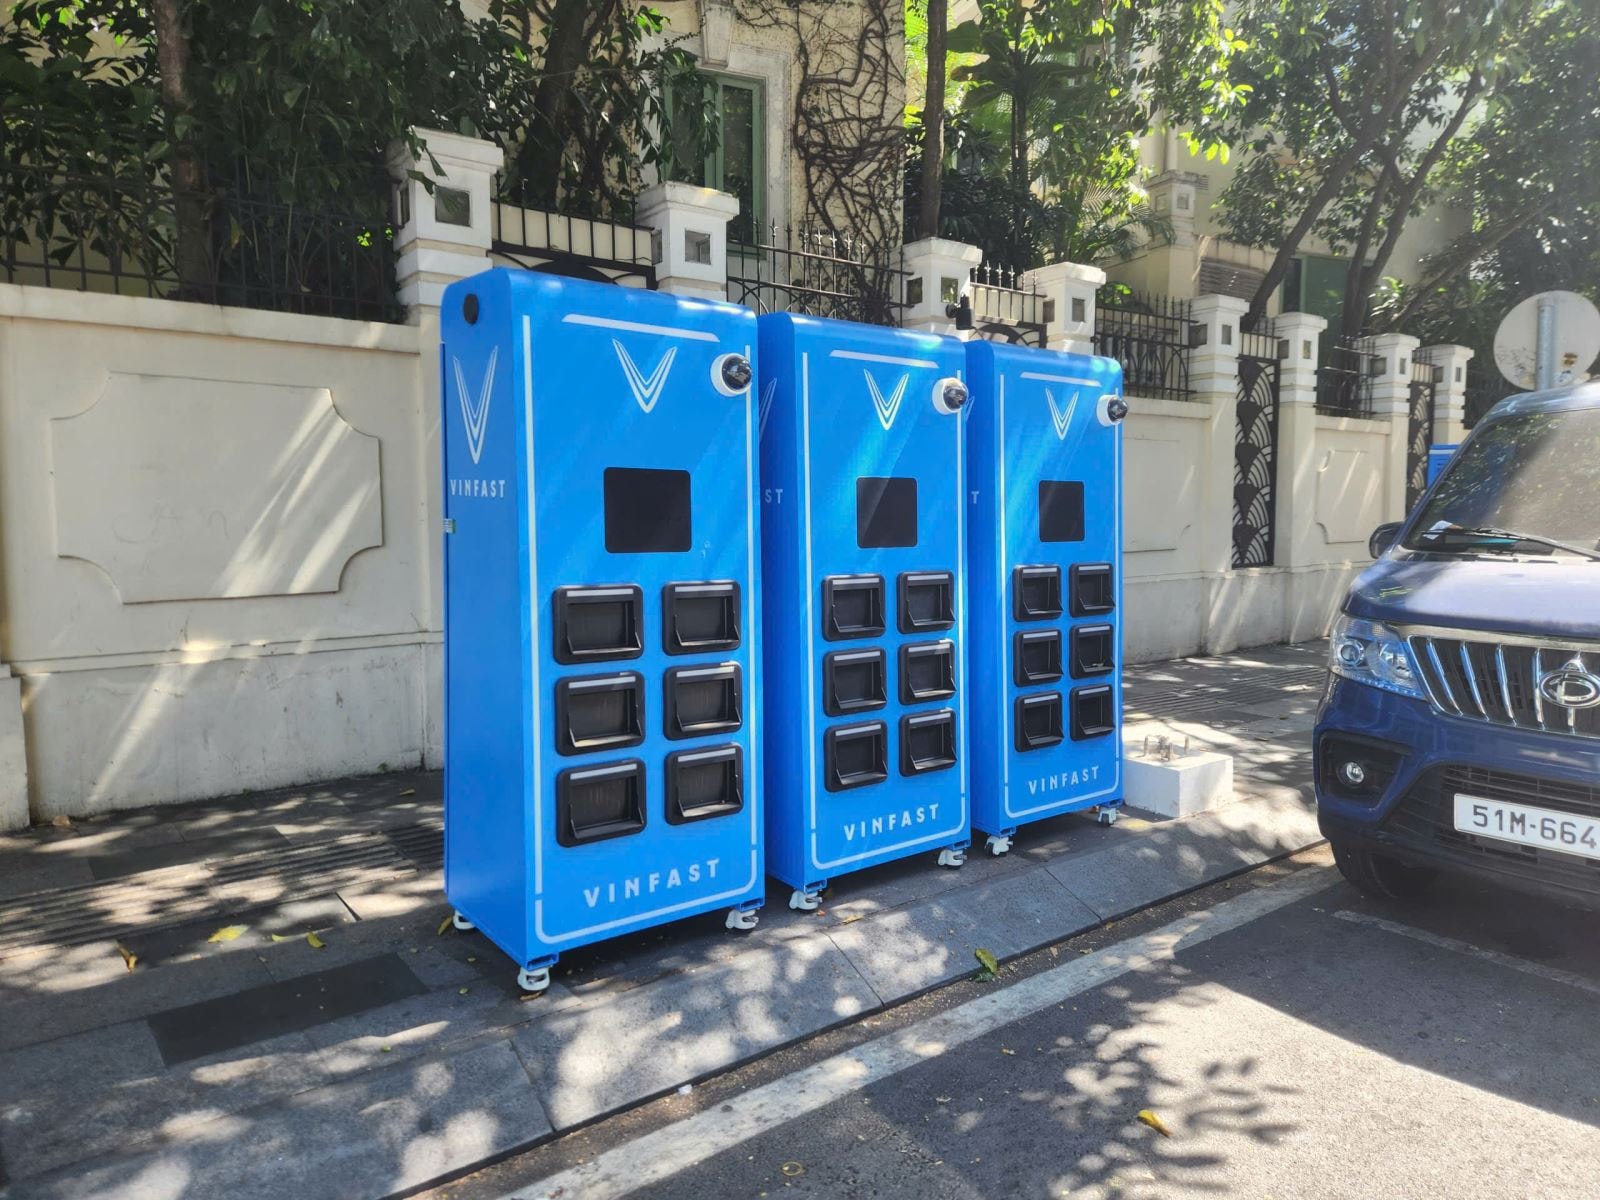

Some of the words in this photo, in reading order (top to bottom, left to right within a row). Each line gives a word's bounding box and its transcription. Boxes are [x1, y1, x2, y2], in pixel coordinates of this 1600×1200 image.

[450, 479, 506, 498] VINFAST
[1028, 765, 1099, 795] VINFAST
[843, 802, 939, 841] VINFAST
[1472, 804, 1598, 849] 51M-664
[583, 858, 720, 908] VINFAST
